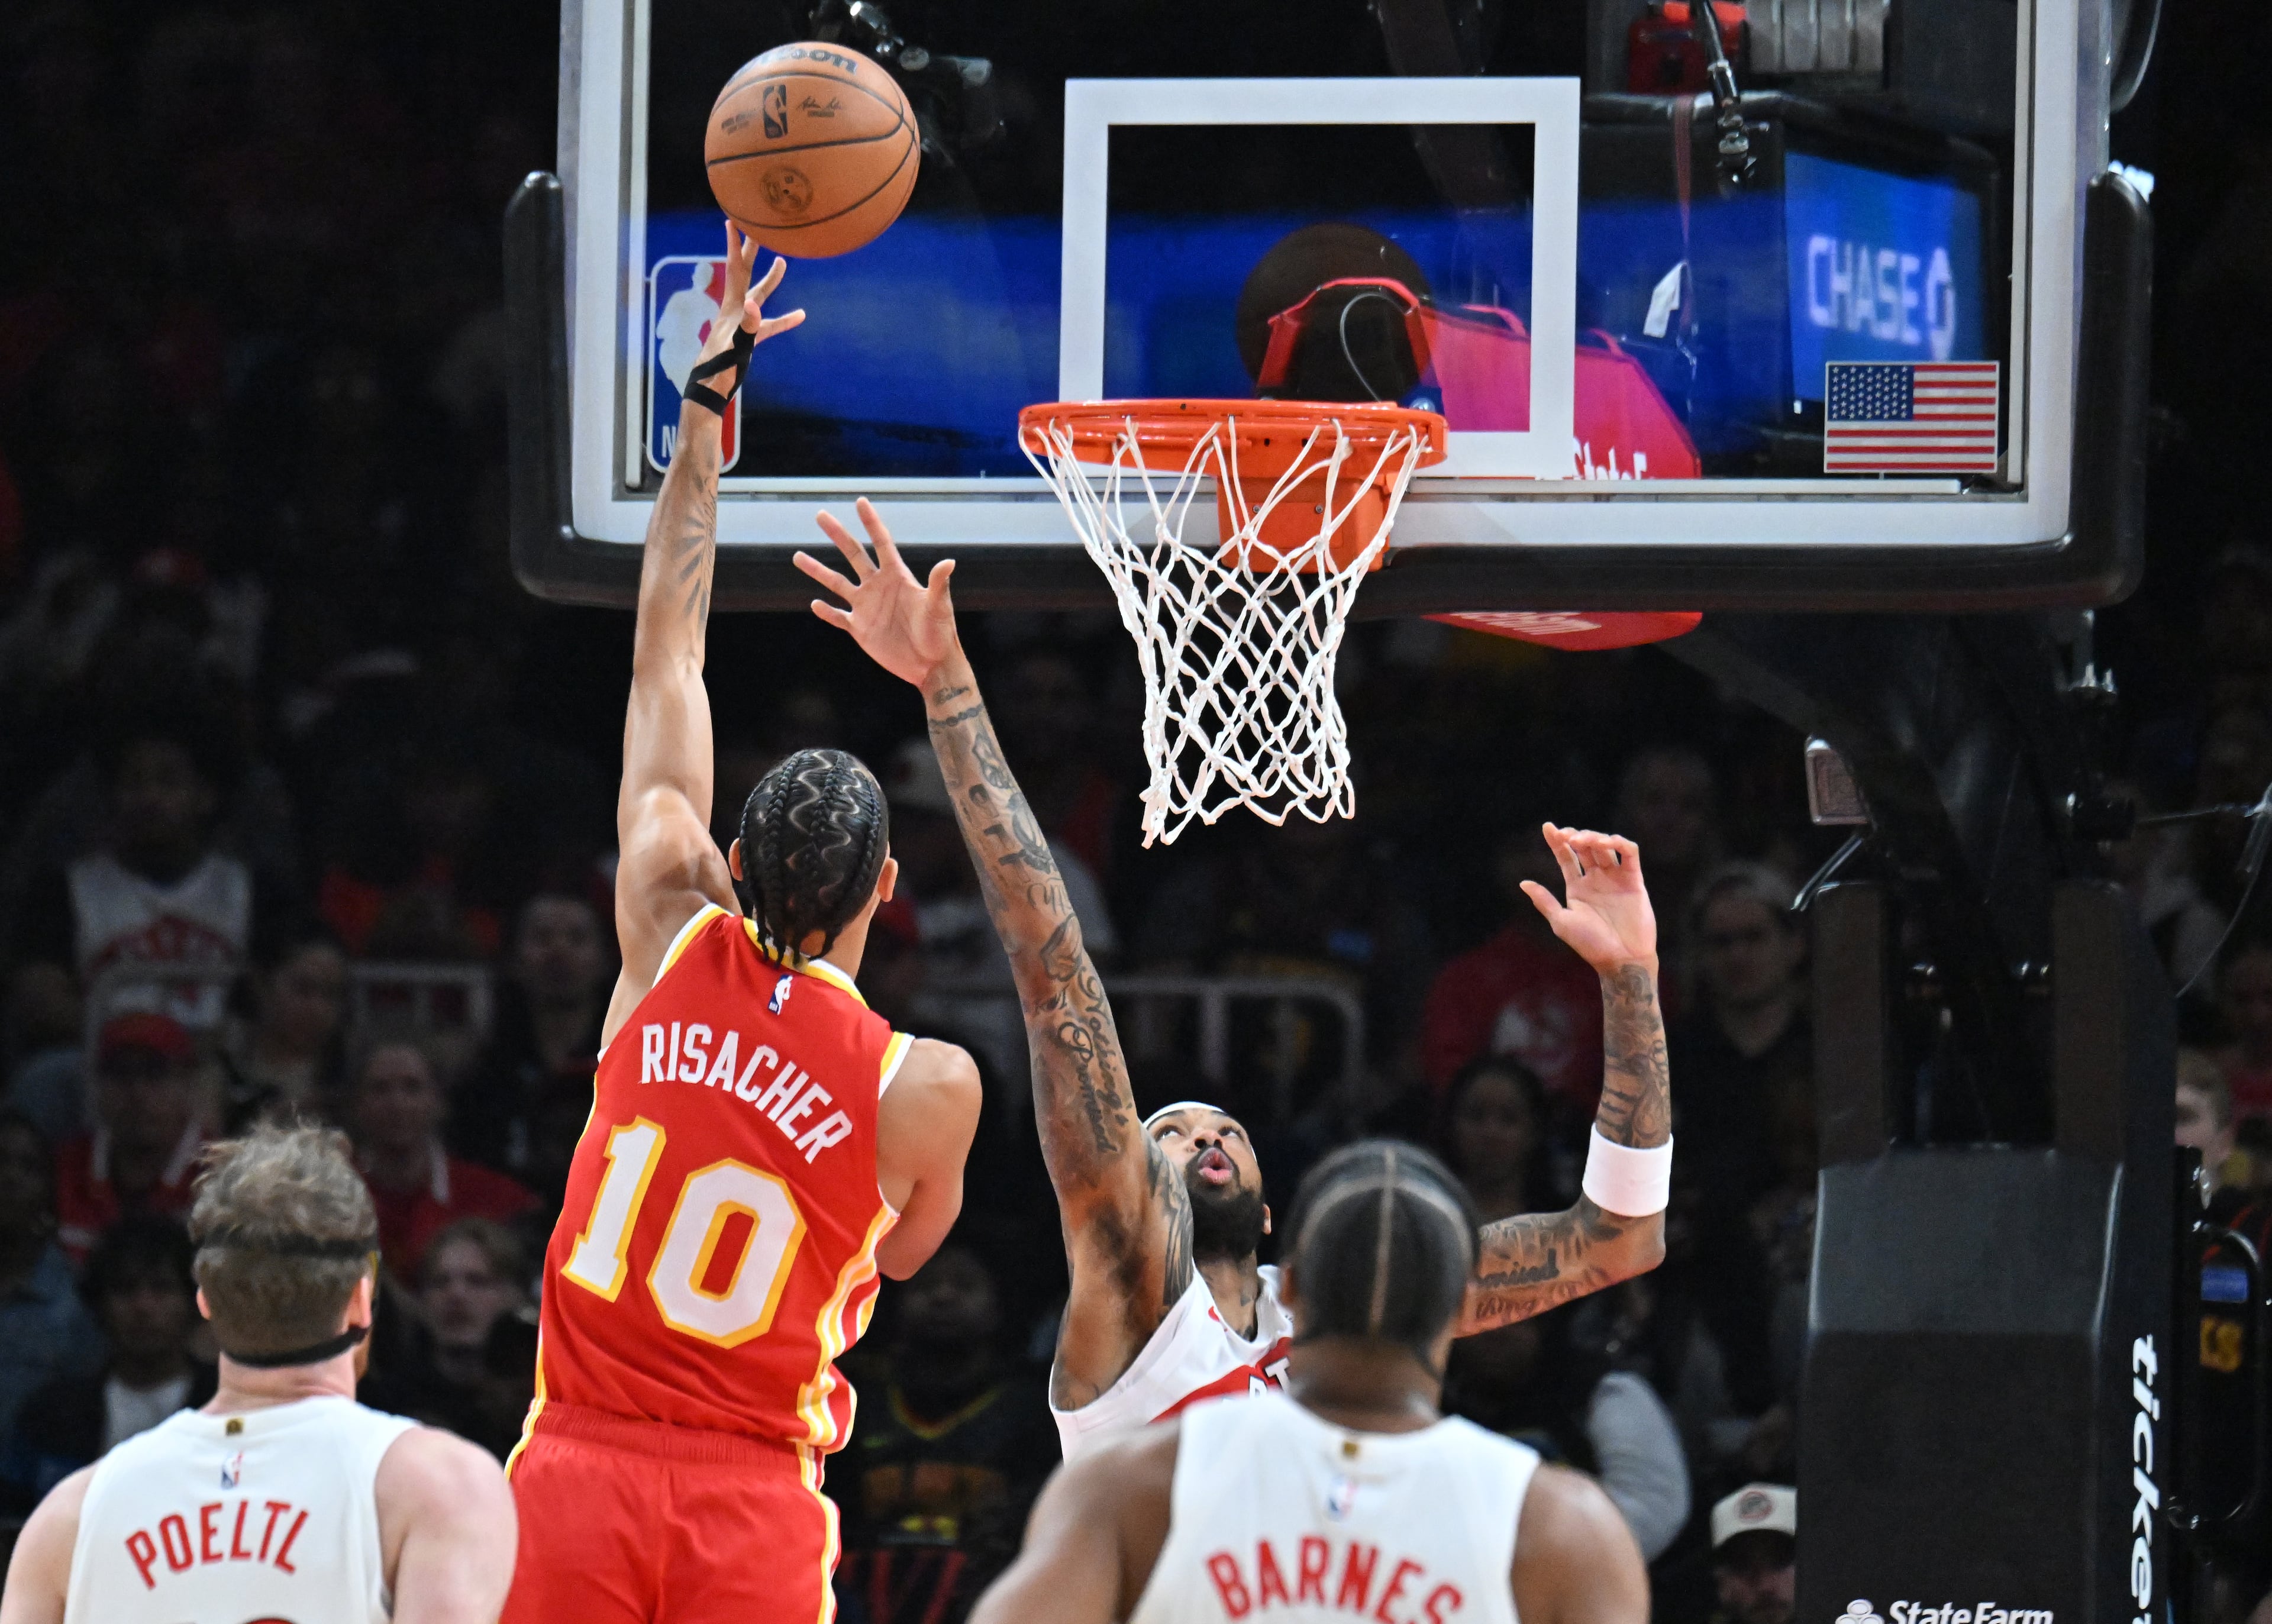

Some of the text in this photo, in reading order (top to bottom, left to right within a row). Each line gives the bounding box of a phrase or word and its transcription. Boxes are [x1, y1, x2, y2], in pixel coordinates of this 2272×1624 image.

[1808, 235, 1921, 345] CHASE
[642, 1022, 853, 1164] RISACHER
[561, 1116, 807, 1349] 10
[2131, 1335, 2160, 1624] ticke
[125, 1500, 309, 1590] POELTL
[1207, 1536, 1463, 1624] BARNES
